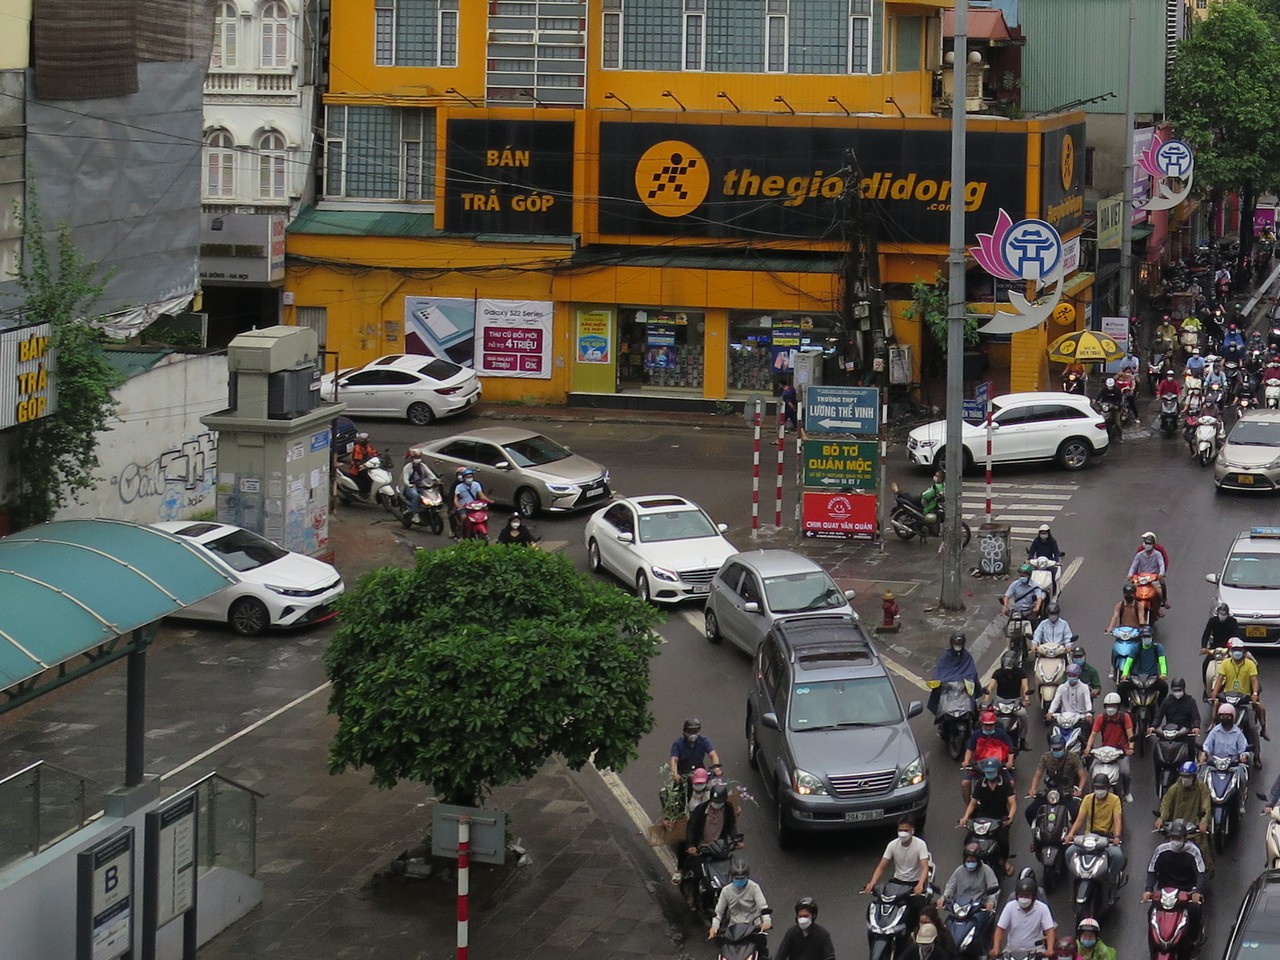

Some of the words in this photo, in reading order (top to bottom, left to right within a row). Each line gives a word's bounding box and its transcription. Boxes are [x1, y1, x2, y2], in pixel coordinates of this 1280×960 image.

[486, 145, 530, 167] BÁN
[723, 168, 987, 212] thegiodidog
[461, 188, 500, 211] TRẢ
[511, 191, 555, 212] GÓP
[484, 309, 508, 317] Galaxy
[522, 310, 544, 318] Series
[525, 361, 538, 369] 0%
[18, 362, 47, 395] TRẢ
[17, 395, 48, 423] GÓP
[809, 404, 836, 417] LƯƠNG
[838, 403, 853, 418] THẾ
[854, 406, 874, 418] VINH
[822, 443, 839, 456] BÒ
[842, 444, 859, 457] TƠ
[846, 457, 872, 474] MỘC
[854, 522, 873, 530] QUÁN
[105, 865, 118, 894] B
